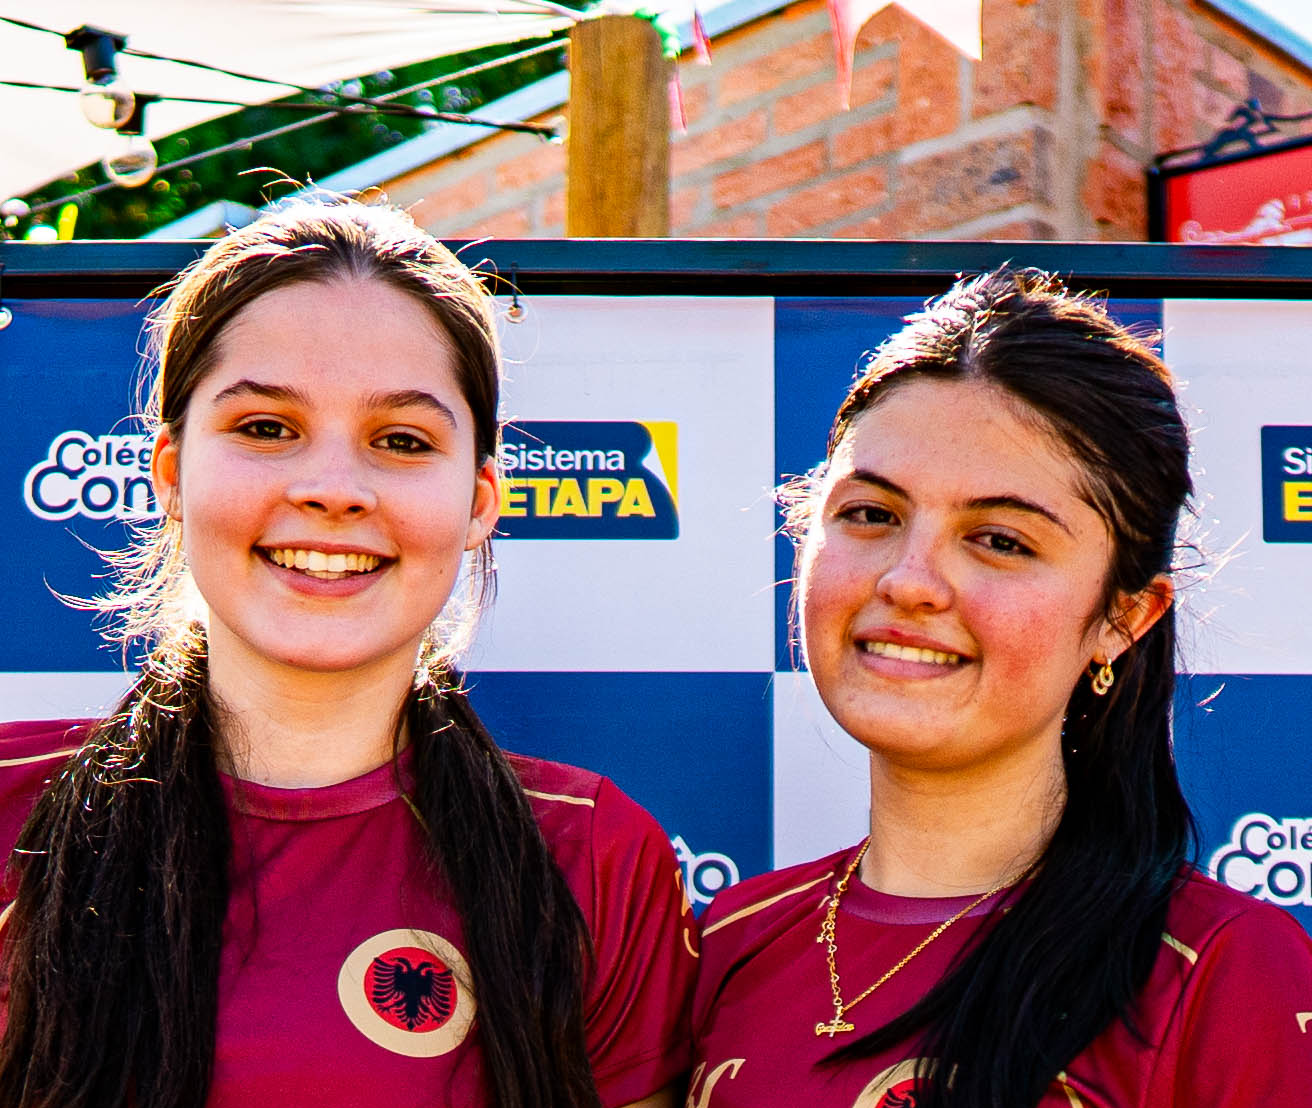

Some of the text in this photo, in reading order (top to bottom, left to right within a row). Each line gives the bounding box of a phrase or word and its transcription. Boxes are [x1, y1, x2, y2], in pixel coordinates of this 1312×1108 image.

[55, 437, 153, 473] Colég
[499, 443, 625, 471] Sistema
[499, 478, 656, 517] ETAPA
